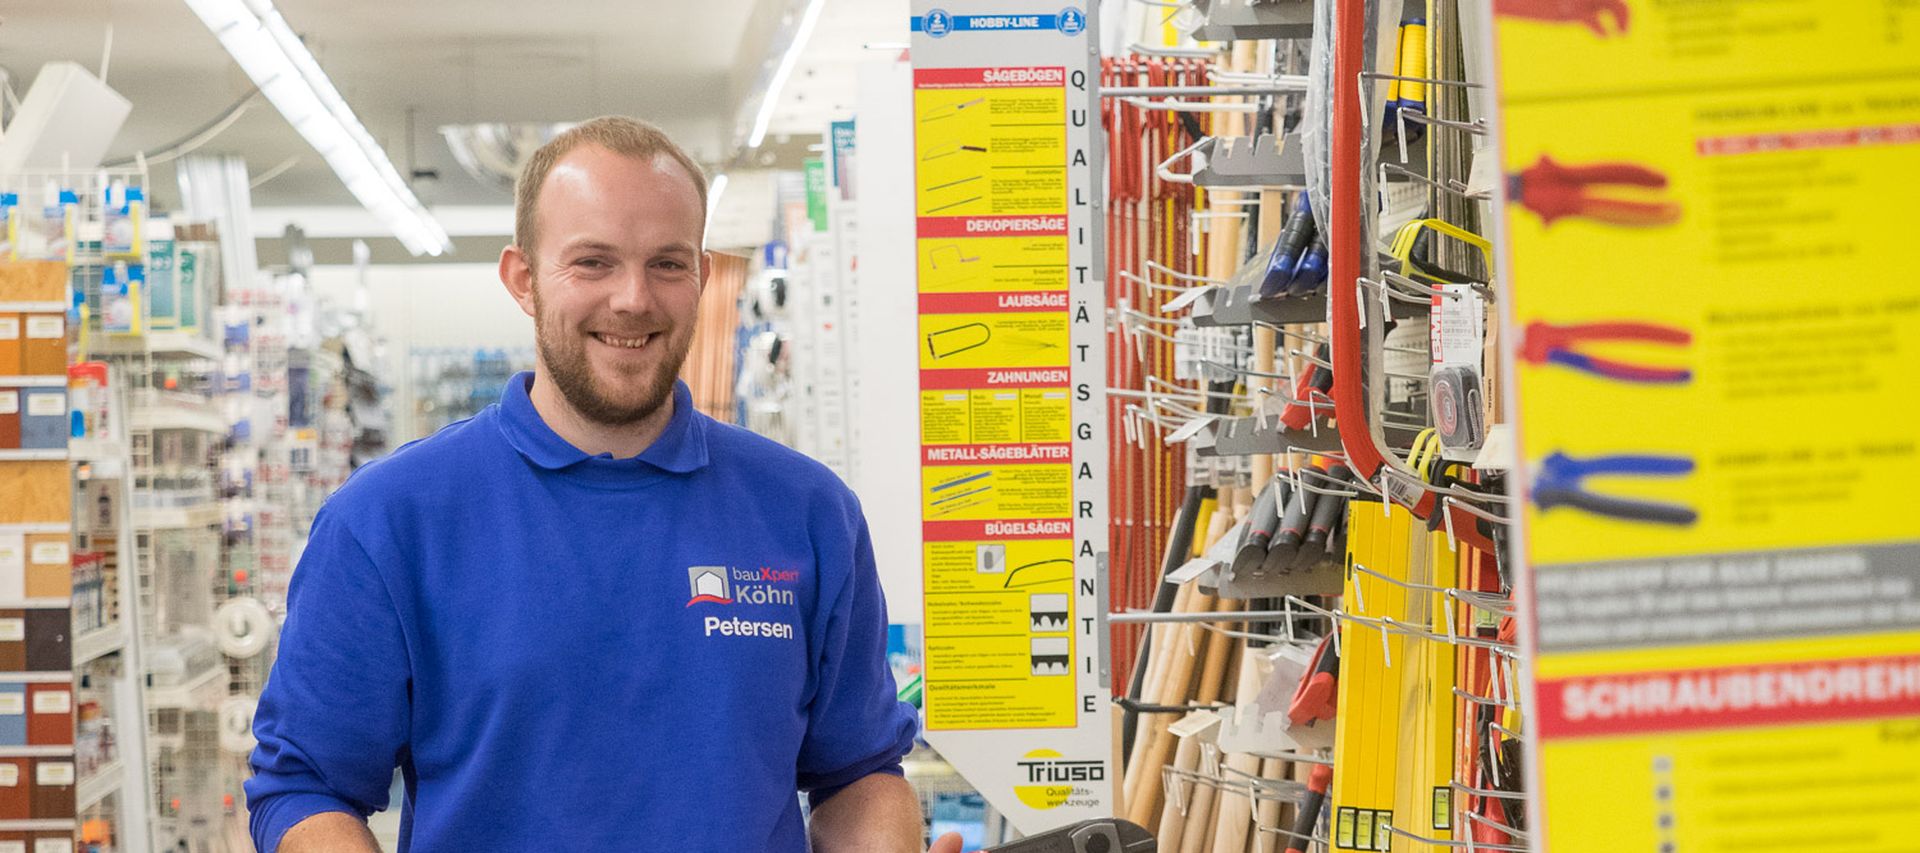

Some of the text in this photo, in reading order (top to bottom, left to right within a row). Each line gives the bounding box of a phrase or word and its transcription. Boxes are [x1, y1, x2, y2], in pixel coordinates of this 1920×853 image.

[970, 16, 1040, 29] HOBBY-LINE
[983, 68, 1063, 83] SÄGEBÖGEN
[966, 217, 1066, 232] DEKOPIERSÄGE
[998, 292, 1067, 308] LAUBSÄGE
[987, 371, 1068, 384] ZAHNUNGEN
[928, 445, 1070, 461] METALL-SÄGEBLÄTTER
[985, 521, 1071, 536] BÜGELSÄGEN
[735, 584, 794, 606] Köhn
[704, 616, 793, 640] Petersen
[1046, 786, 1094, 798] Qualitäts-
[1046, 798, 1100, 808] werkzeuge
